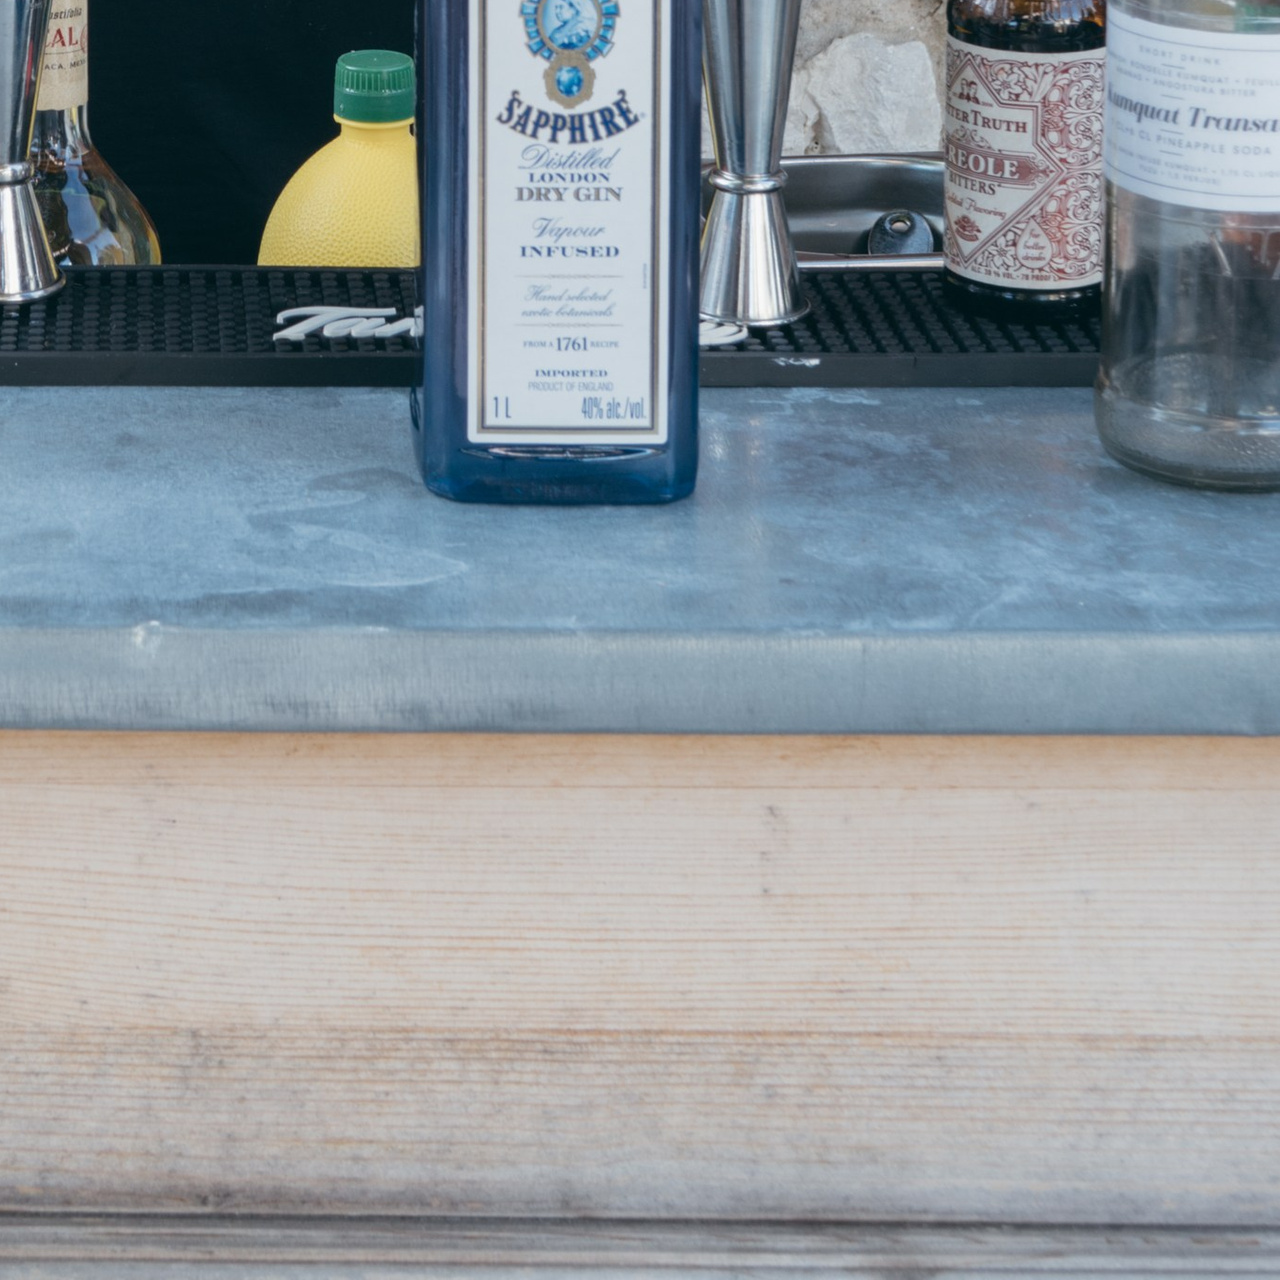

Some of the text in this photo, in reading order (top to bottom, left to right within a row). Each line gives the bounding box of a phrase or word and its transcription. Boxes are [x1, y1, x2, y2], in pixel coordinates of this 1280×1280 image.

[46, 26, 79, 48] AL
[1220, 88, 1257, 98] BITTER
[495, 89, 640, 144] SAPPHIRE
[970, 108, 1028, 134] TRUTH
[1156, 134, 1226, 154] PINEAPPLE
[1232, 145, 1272, 156] SODA
[517, 143, 622, 170] Distilled
[528, 172, 612, 184] LONDON
[515, 187, 624, 203] DRY GIN
[531, 217, 607, 244] Vapour
[520, 246, 620, 258] INFUSED
[524, 285, 614, 302] Hand selected
[521, 303, 617, 317] exotic botanicals
[556, 337, 588, 352] 1761
[535, 369, 608, 378] IMPORTED
[528, 381, 615, 392] PRODUCT OF ENGLAND
[493, 396, 499, 419] 1
[505, 396, 512, 419] L
[581, 397, 604, 419] 40%
